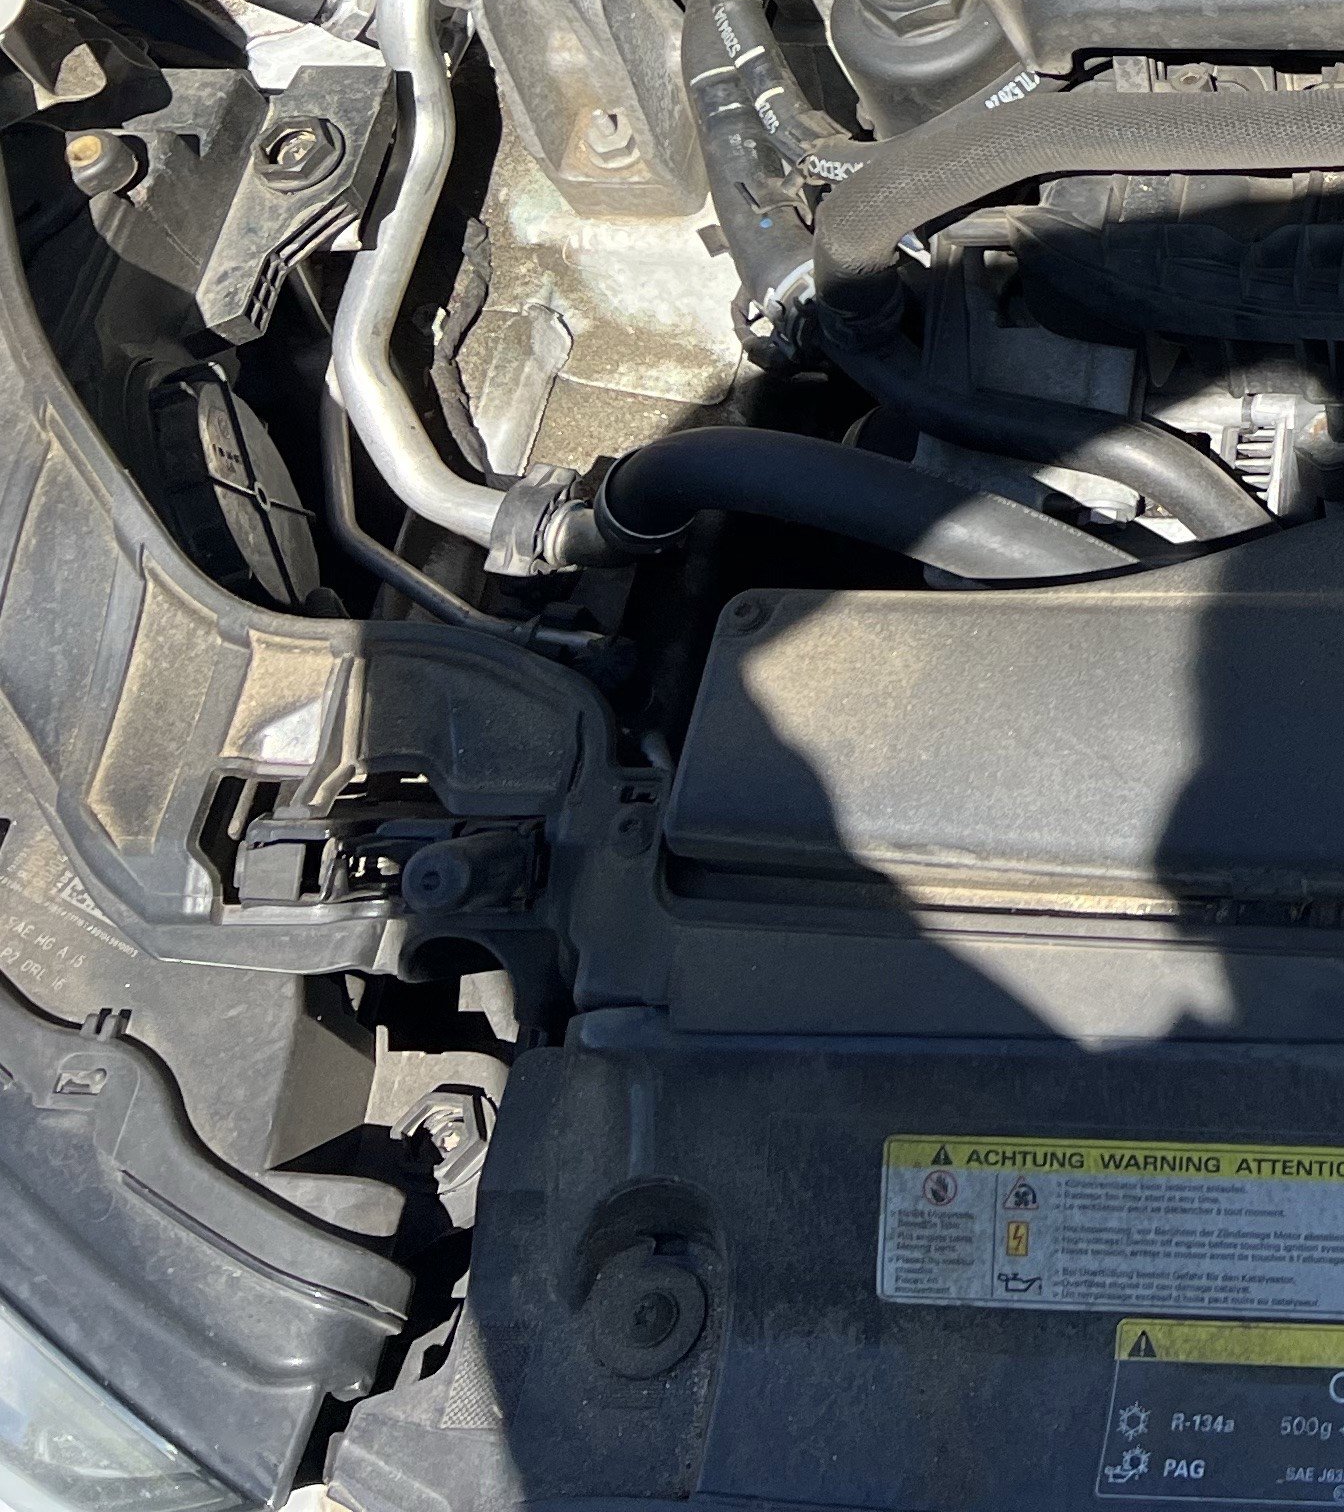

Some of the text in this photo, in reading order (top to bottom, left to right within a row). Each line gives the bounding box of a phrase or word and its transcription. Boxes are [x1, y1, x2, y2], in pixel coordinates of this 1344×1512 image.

[8, 916, 35, 939] SAE
[34, 931, 56, 951] HG
[56, 946, 69, 959] A
[966, 1149, 1085, 1170] ACHTUNG
[1100, 1152, 1221, 1174] WARNING
[1171, 1412, 1236, 1434] R-134a
[1280, 1416, 1331, 1440] 500g
[1163, 1458, 1206, 1480] PAG
[1284, 1467, 1313, 1482] SAE
